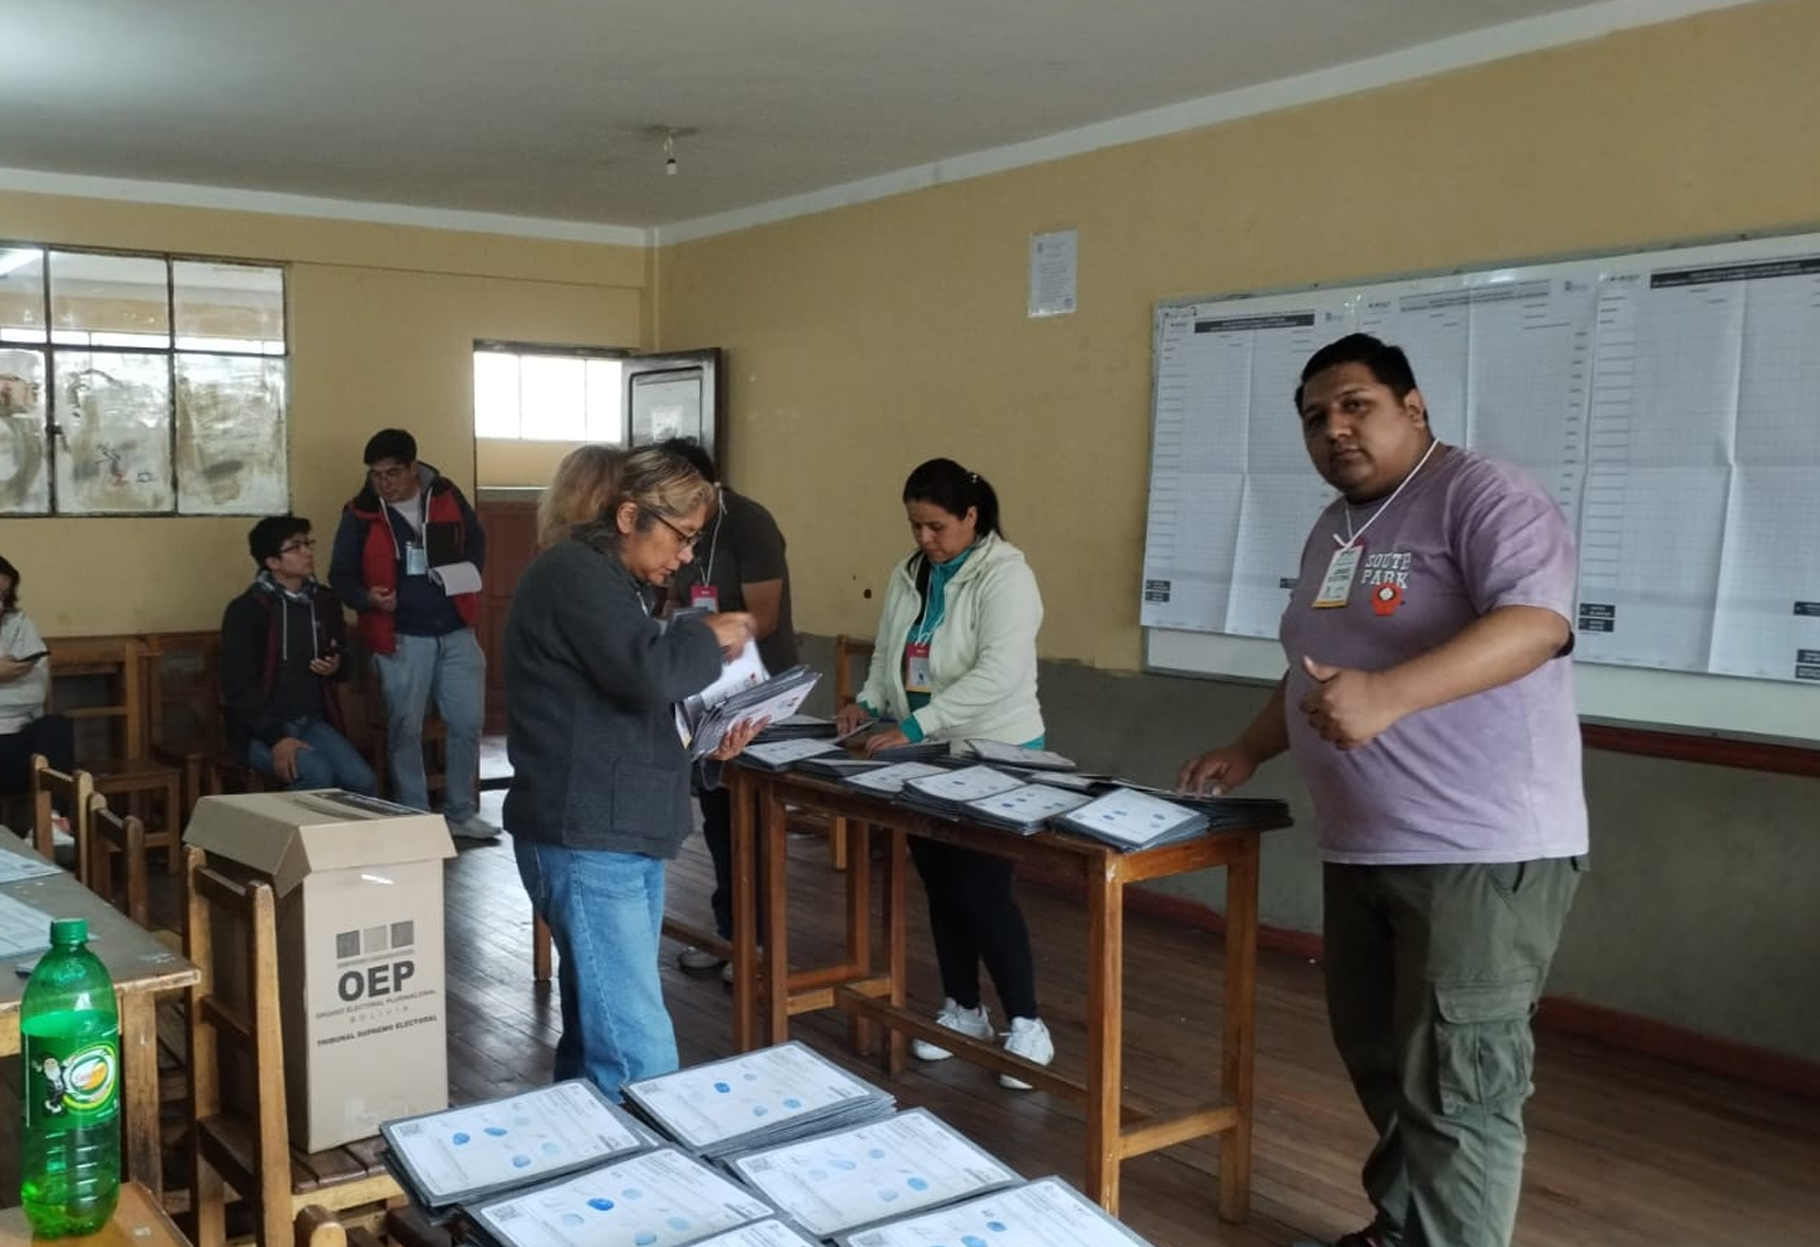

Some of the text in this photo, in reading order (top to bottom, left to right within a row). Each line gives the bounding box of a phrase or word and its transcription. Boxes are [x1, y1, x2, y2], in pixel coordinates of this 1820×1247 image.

[1364, 552, 1411, 570] SOUTH
[1360, 569, 1408, 589] PARK
[338, 960, 415, 1002] OEP
[395, 1015, 438, 1030] ELECTORAL
